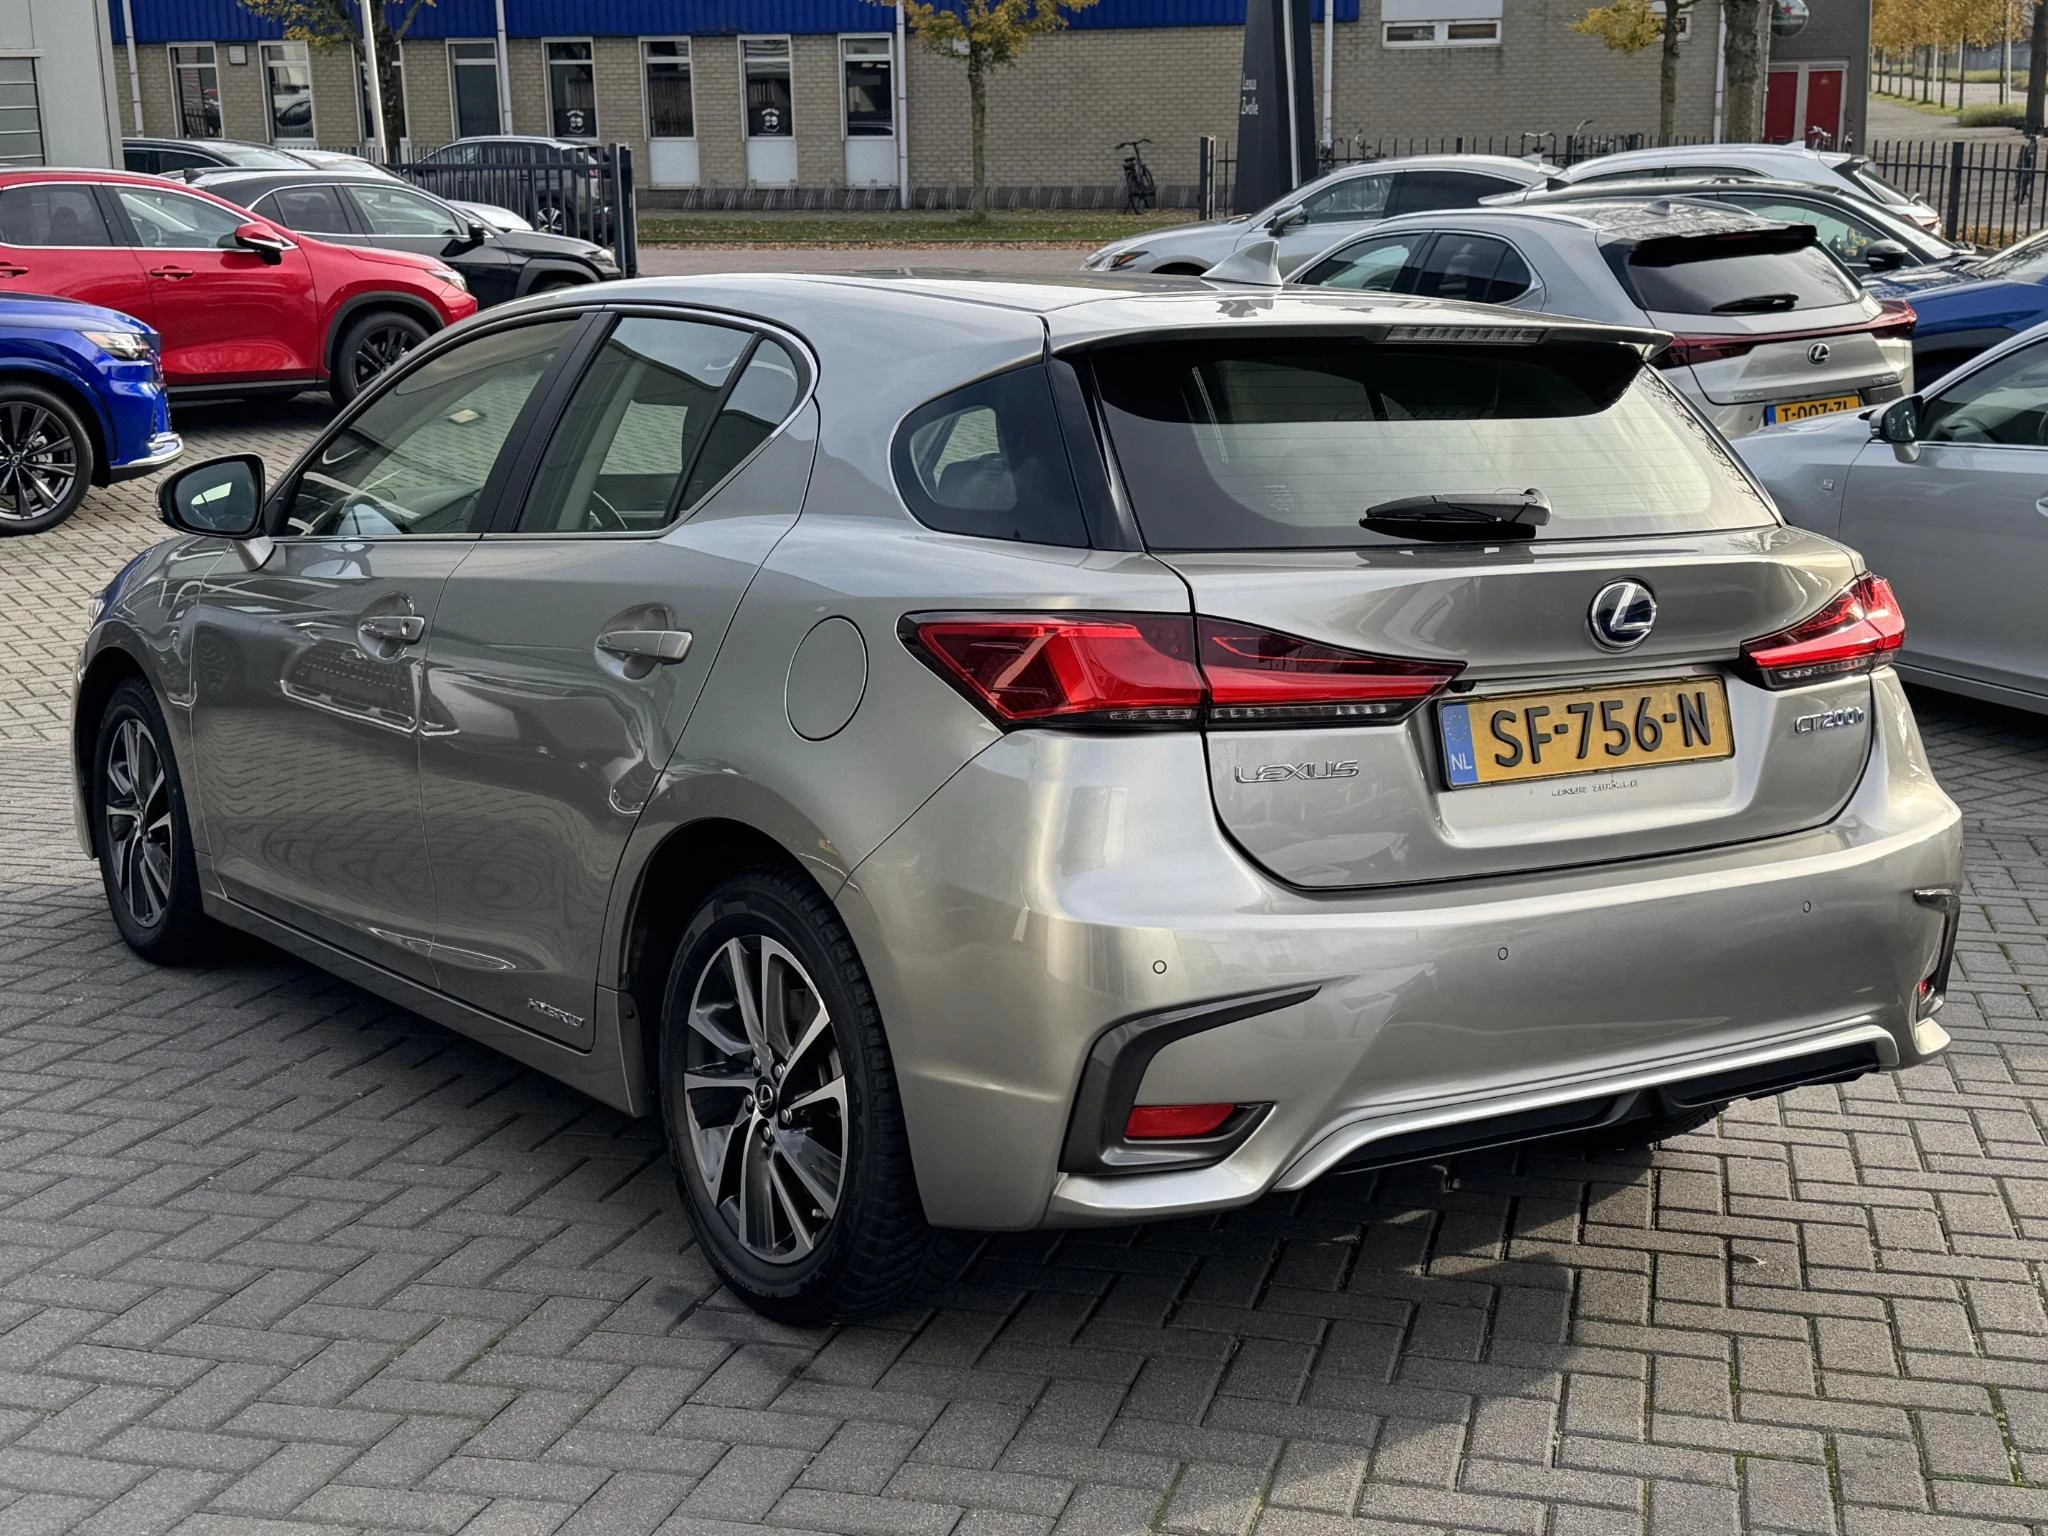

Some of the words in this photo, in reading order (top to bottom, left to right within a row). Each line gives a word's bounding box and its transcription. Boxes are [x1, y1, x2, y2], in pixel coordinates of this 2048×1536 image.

[1242, 72, 1257, 90] Lexus
[1241, 97, 1258, 115] Zwolle
[1490, 692, 1711, 767] SF-756-N
[1451, 752, 1473, 771] NL
[1235, 760, 1359, 783] LEXUS
